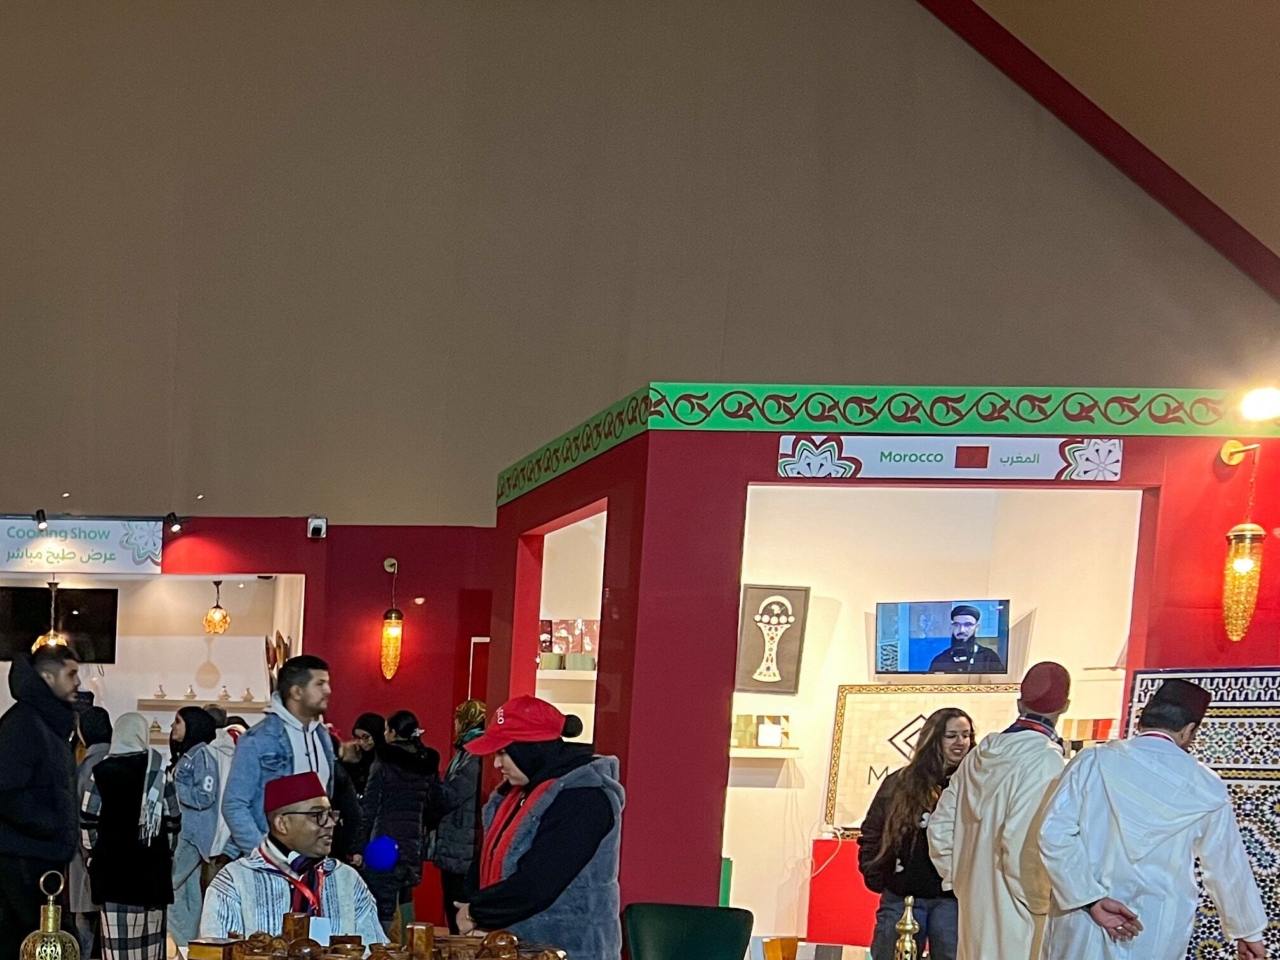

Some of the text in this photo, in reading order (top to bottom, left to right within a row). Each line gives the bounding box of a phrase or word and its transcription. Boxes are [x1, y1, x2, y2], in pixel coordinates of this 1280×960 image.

[879, 451, 944, 463] Morocco
[999, 453, 1040, 467] المغرب
[70, 526, 111, 540] Show
[6, 546, 117, 564] عرض طبخ مباشر
[203, 775, 214, 792] 8
